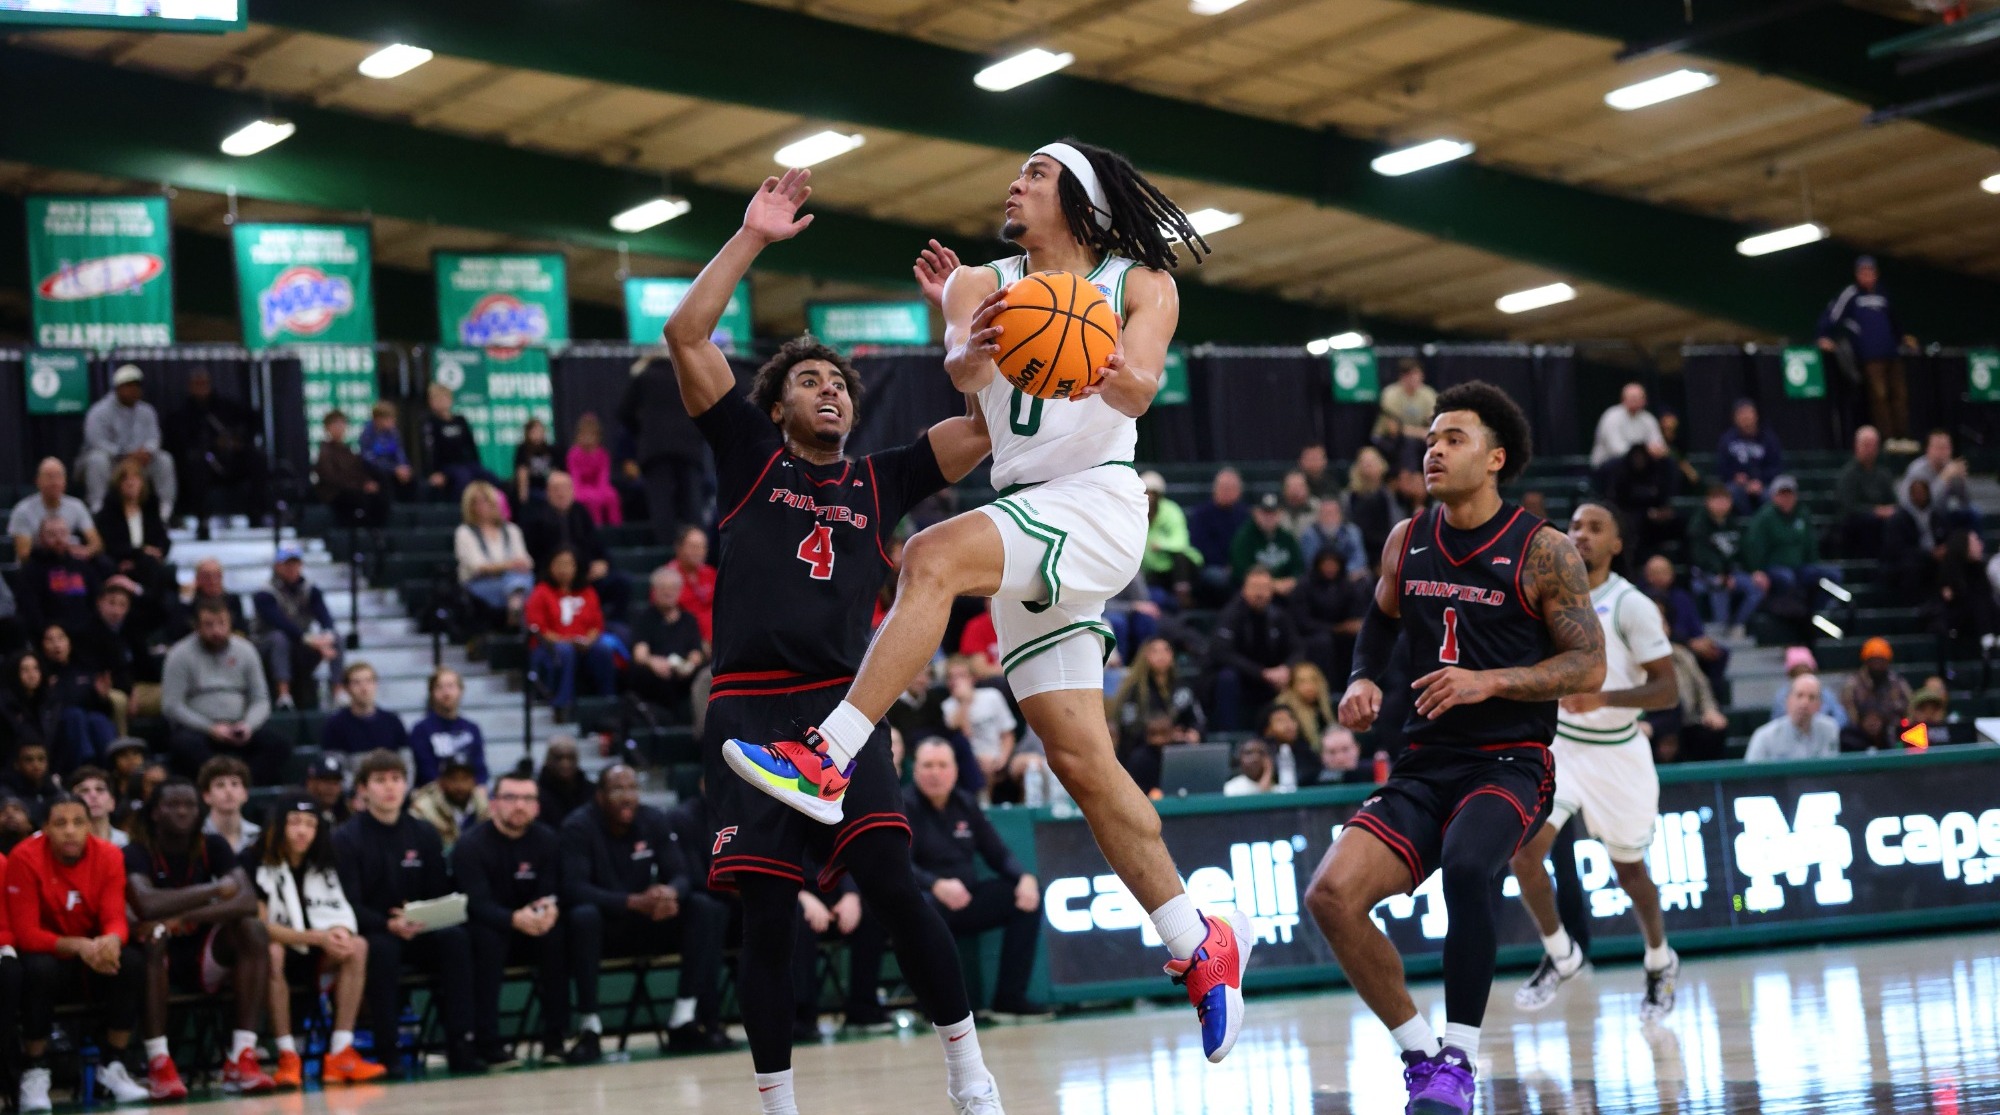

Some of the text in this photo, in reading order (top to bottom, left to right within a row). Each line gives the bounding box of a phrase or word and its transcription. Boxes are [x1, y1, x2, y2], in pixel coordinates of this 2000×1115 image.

[39, 323, 171, 349] CHAMPIONS
[769, 488, 867, 529] FAIRFIELD
[797, 521, 834, 580] 4
[1405, 580, 1505, 606] FAIRFIELD
[1439, 607, 1459, 664] 1
[712, 825, 738, 855] F
